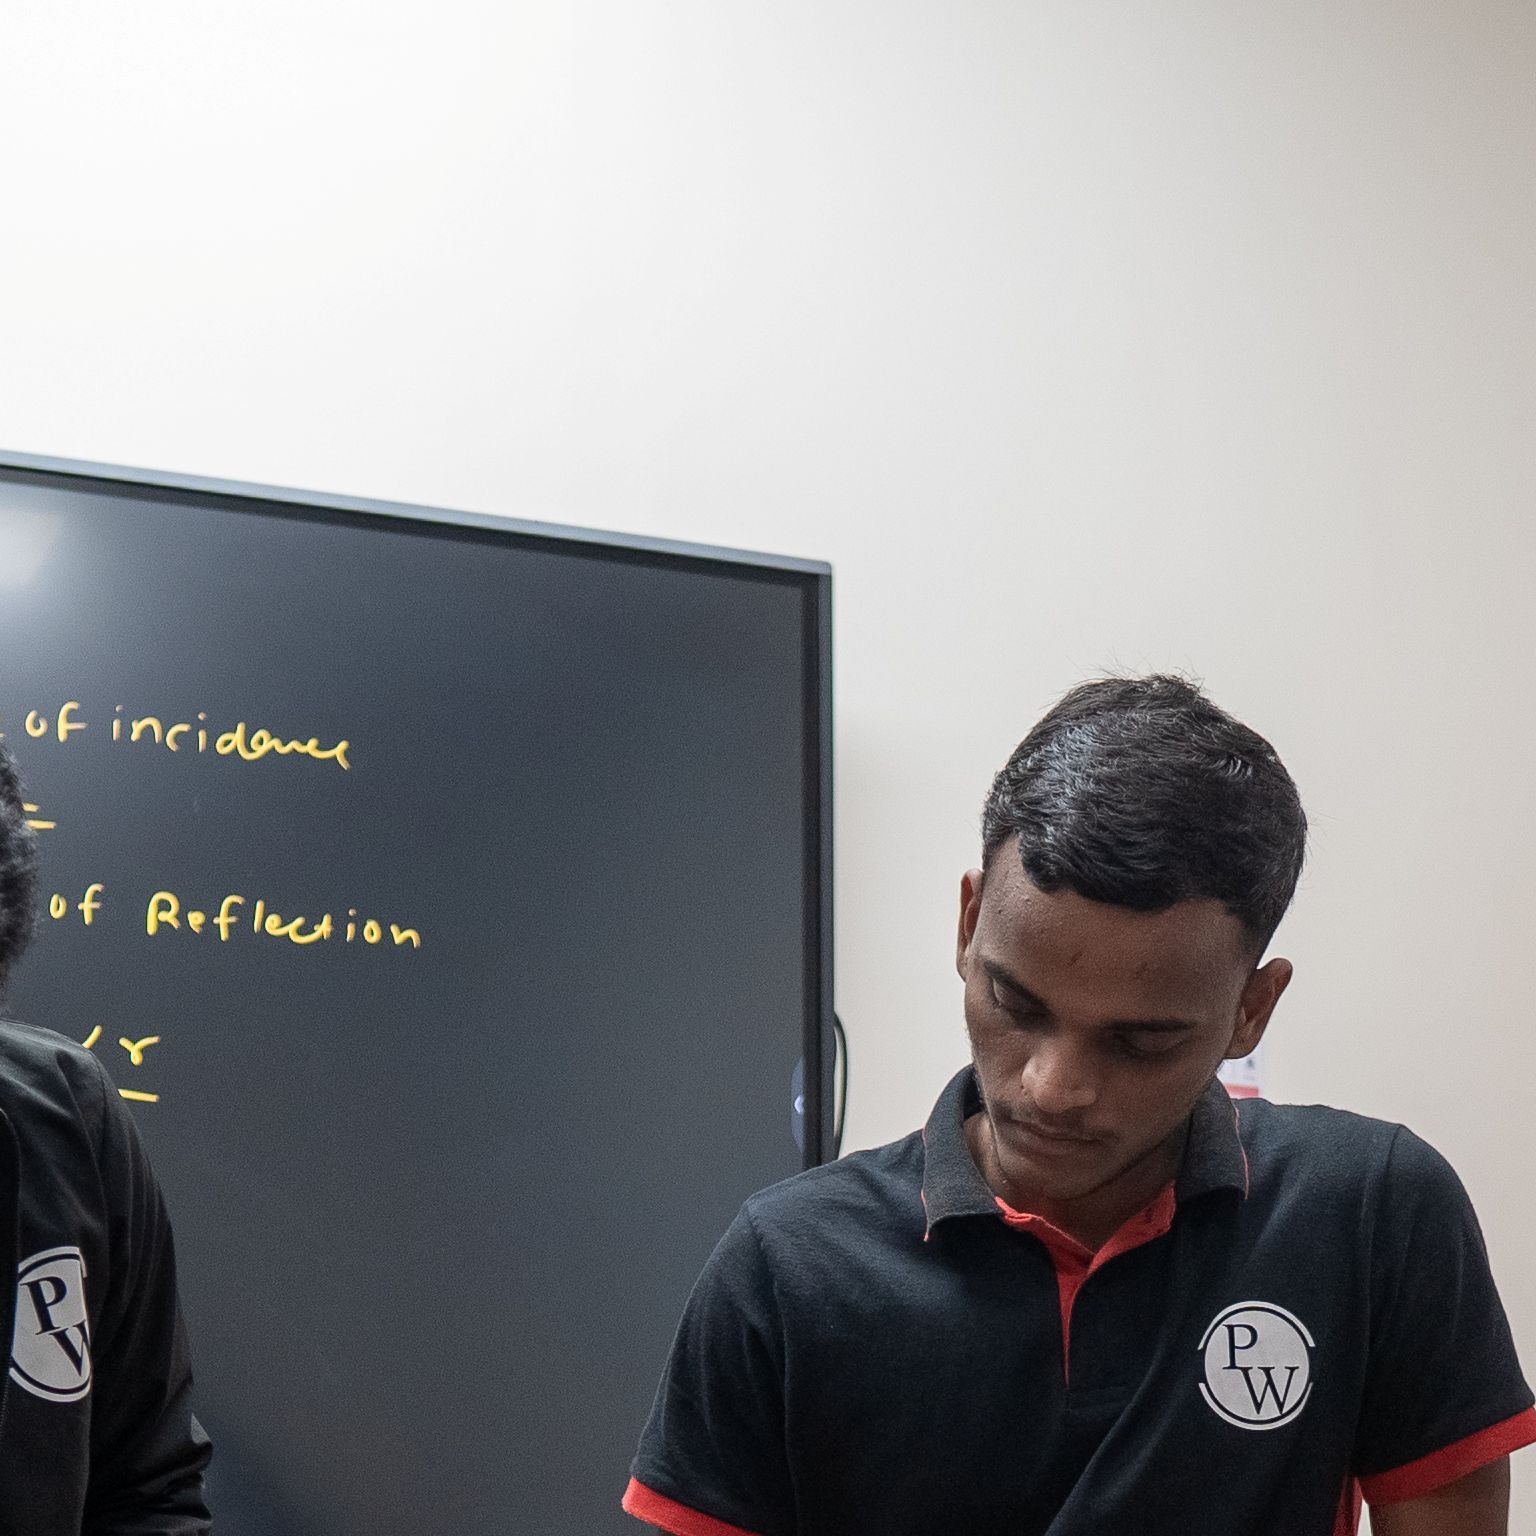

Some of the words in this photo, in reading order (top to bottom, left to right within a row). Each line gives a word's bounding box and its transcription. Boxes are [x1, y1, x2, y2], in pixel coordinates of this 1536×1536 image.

[24, 701, 88, 743] of
[49, 883, 104, 926] of
[145, 890, 422, 949] Reflection
[1221, 1323, 1300, 1416] PW
